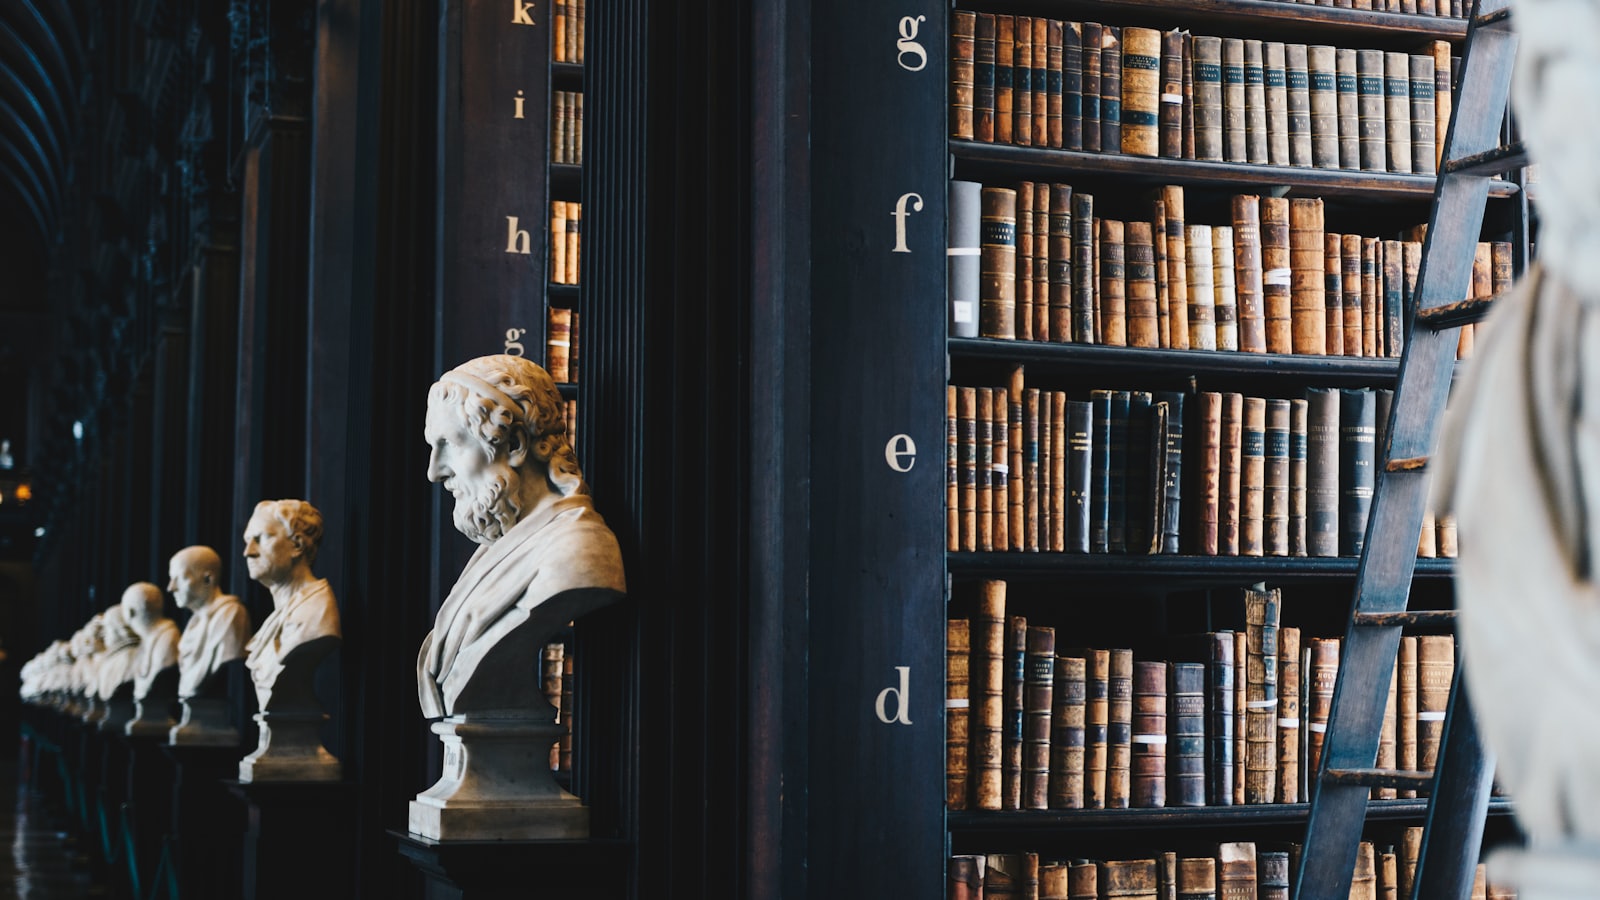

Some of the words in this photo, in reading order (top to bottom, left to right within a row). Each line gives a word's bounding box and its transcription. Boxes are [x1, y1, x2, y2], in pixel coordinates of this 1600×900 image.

[512, 0, 535, 25] k
[896, 14, 928, 72] g
[514, 90, 525, 119] i
[505, 215, 531, 255] h
[890, 192, 924, 253] f
[503, 327, 527, 357] g
[885, 433, 917, 473] e
[875, 666, 913, 725] d
